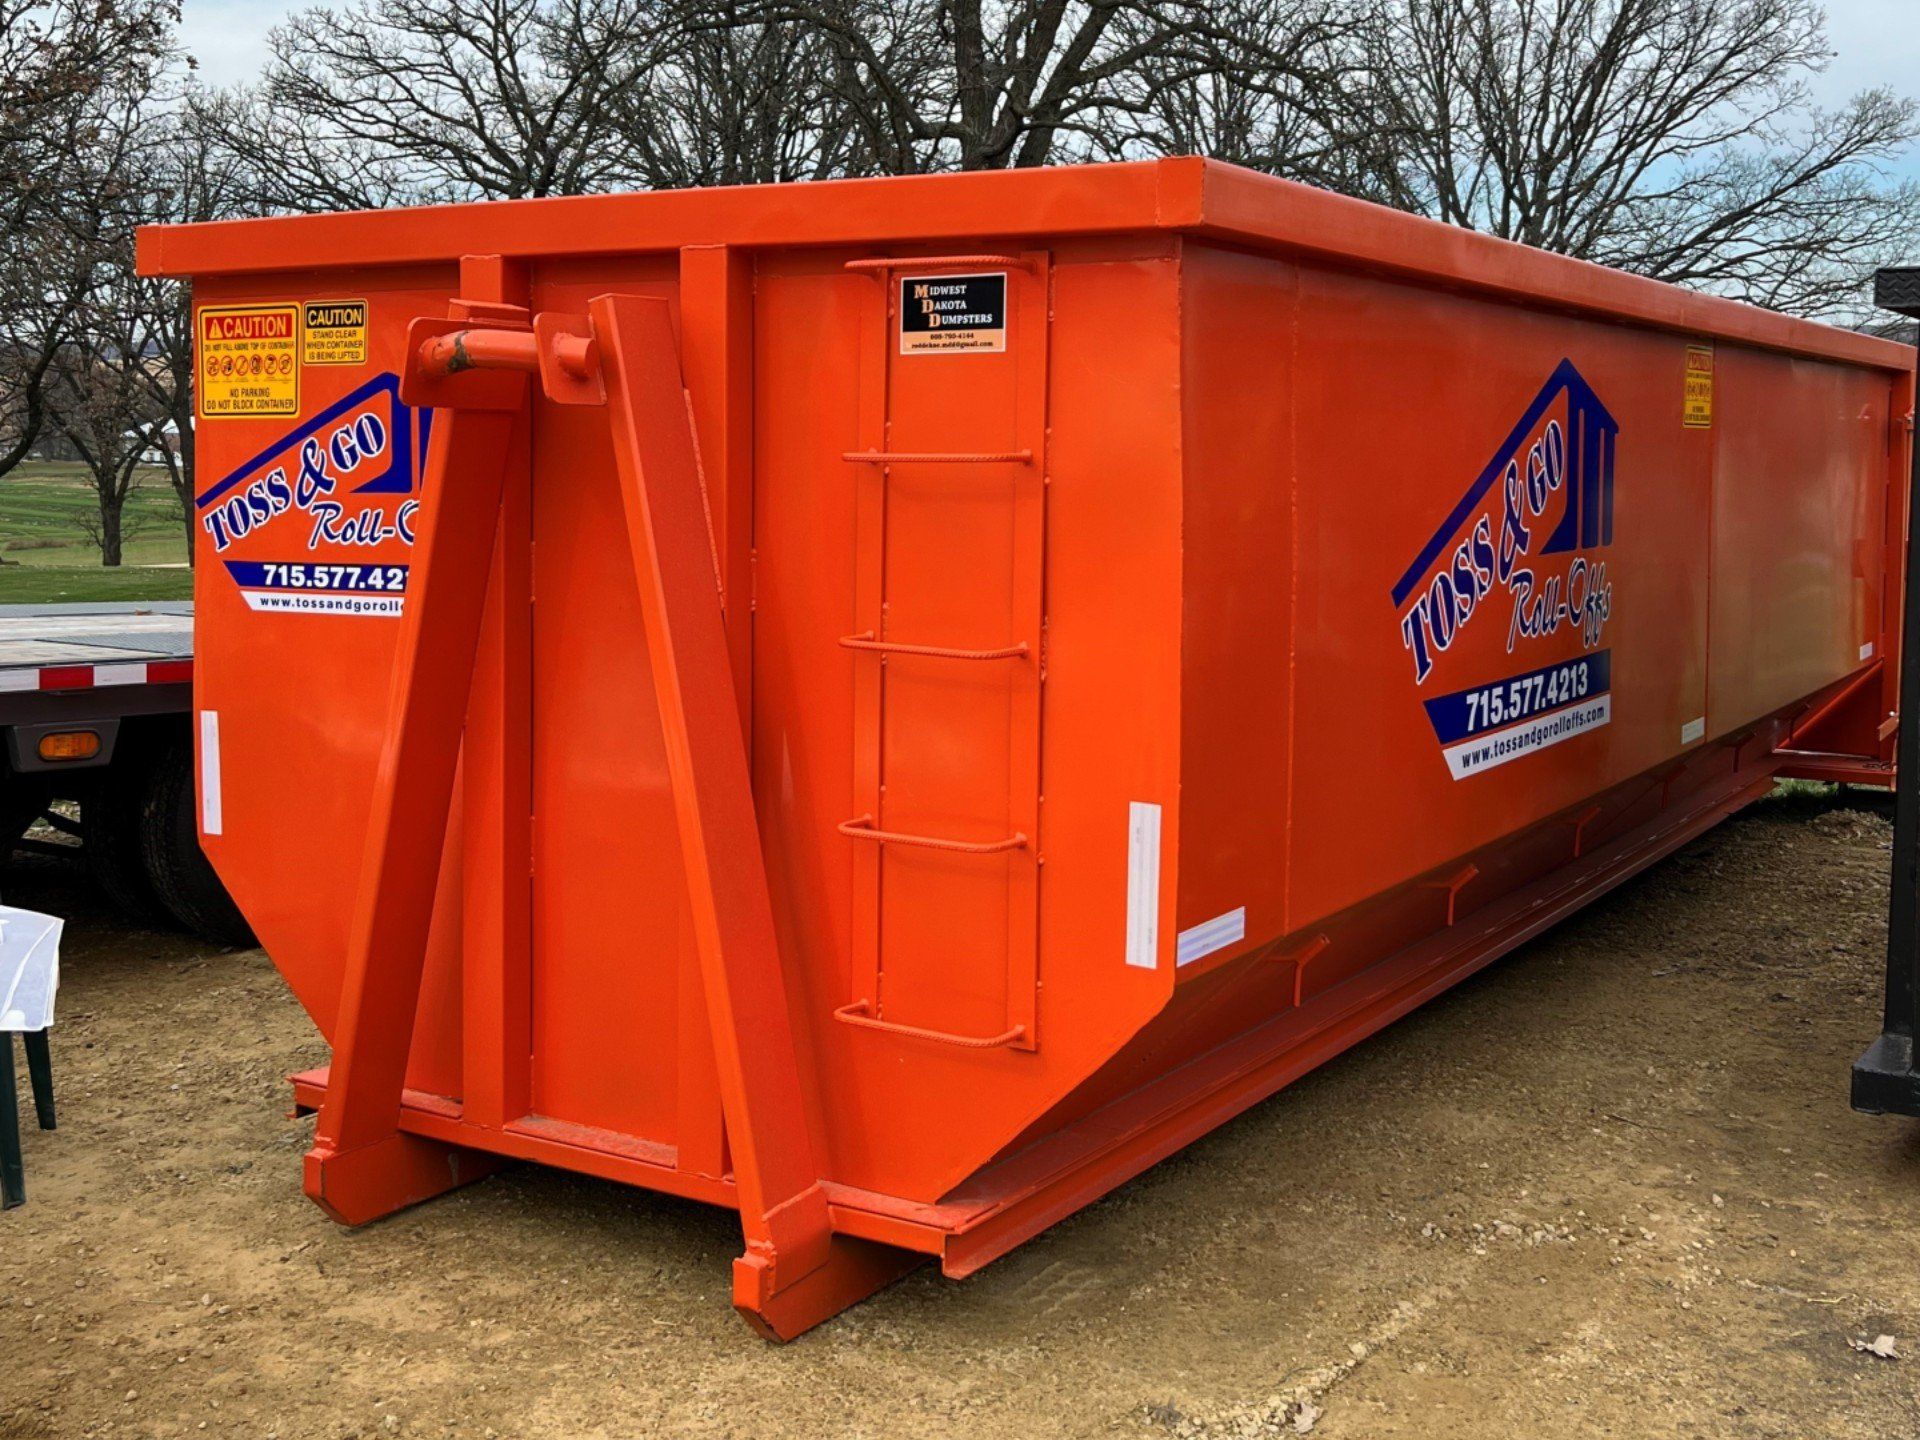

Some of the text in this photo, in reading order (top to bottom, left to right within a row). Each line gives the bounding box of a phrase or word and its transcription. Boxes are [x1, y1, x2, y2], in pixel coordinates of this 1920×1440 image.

[913, 284, 967, 299] MIDWEST
[921, 299, 967, 313] DAKOTA
[307, 307, 363, 326] CAUTION
[928, 313, 993, 328] DUMPSTERS
[223, 316, 287, 337] CAUTION
[312, 329, 357, 339] STAND CLEAR
[306, 340, 363, 350] WHEN CONTAINER
[308, 351, 360, 360] IS BEING LIFTED
[229, 387, 270, 398] NO PARKING
[206, 399, 294, 410] DO NOT BLOCK CONTAINER
[203, 412, 386, 552] TOSS & GO
[308, 499, 420, 551] Roll-O
[1402, 419, 1564, 685] TOSS & GO
[263, 564, 408, 590] 715.577.42
[260, 597, 403, 612] www.tossandgoroll
[1507, 557, 1612, 654] Roll-Offs
[1466, 662, 1588, 732] 715.577.4213
[1462, 705, 1605, 768] www.tossandgorolloffs.com
